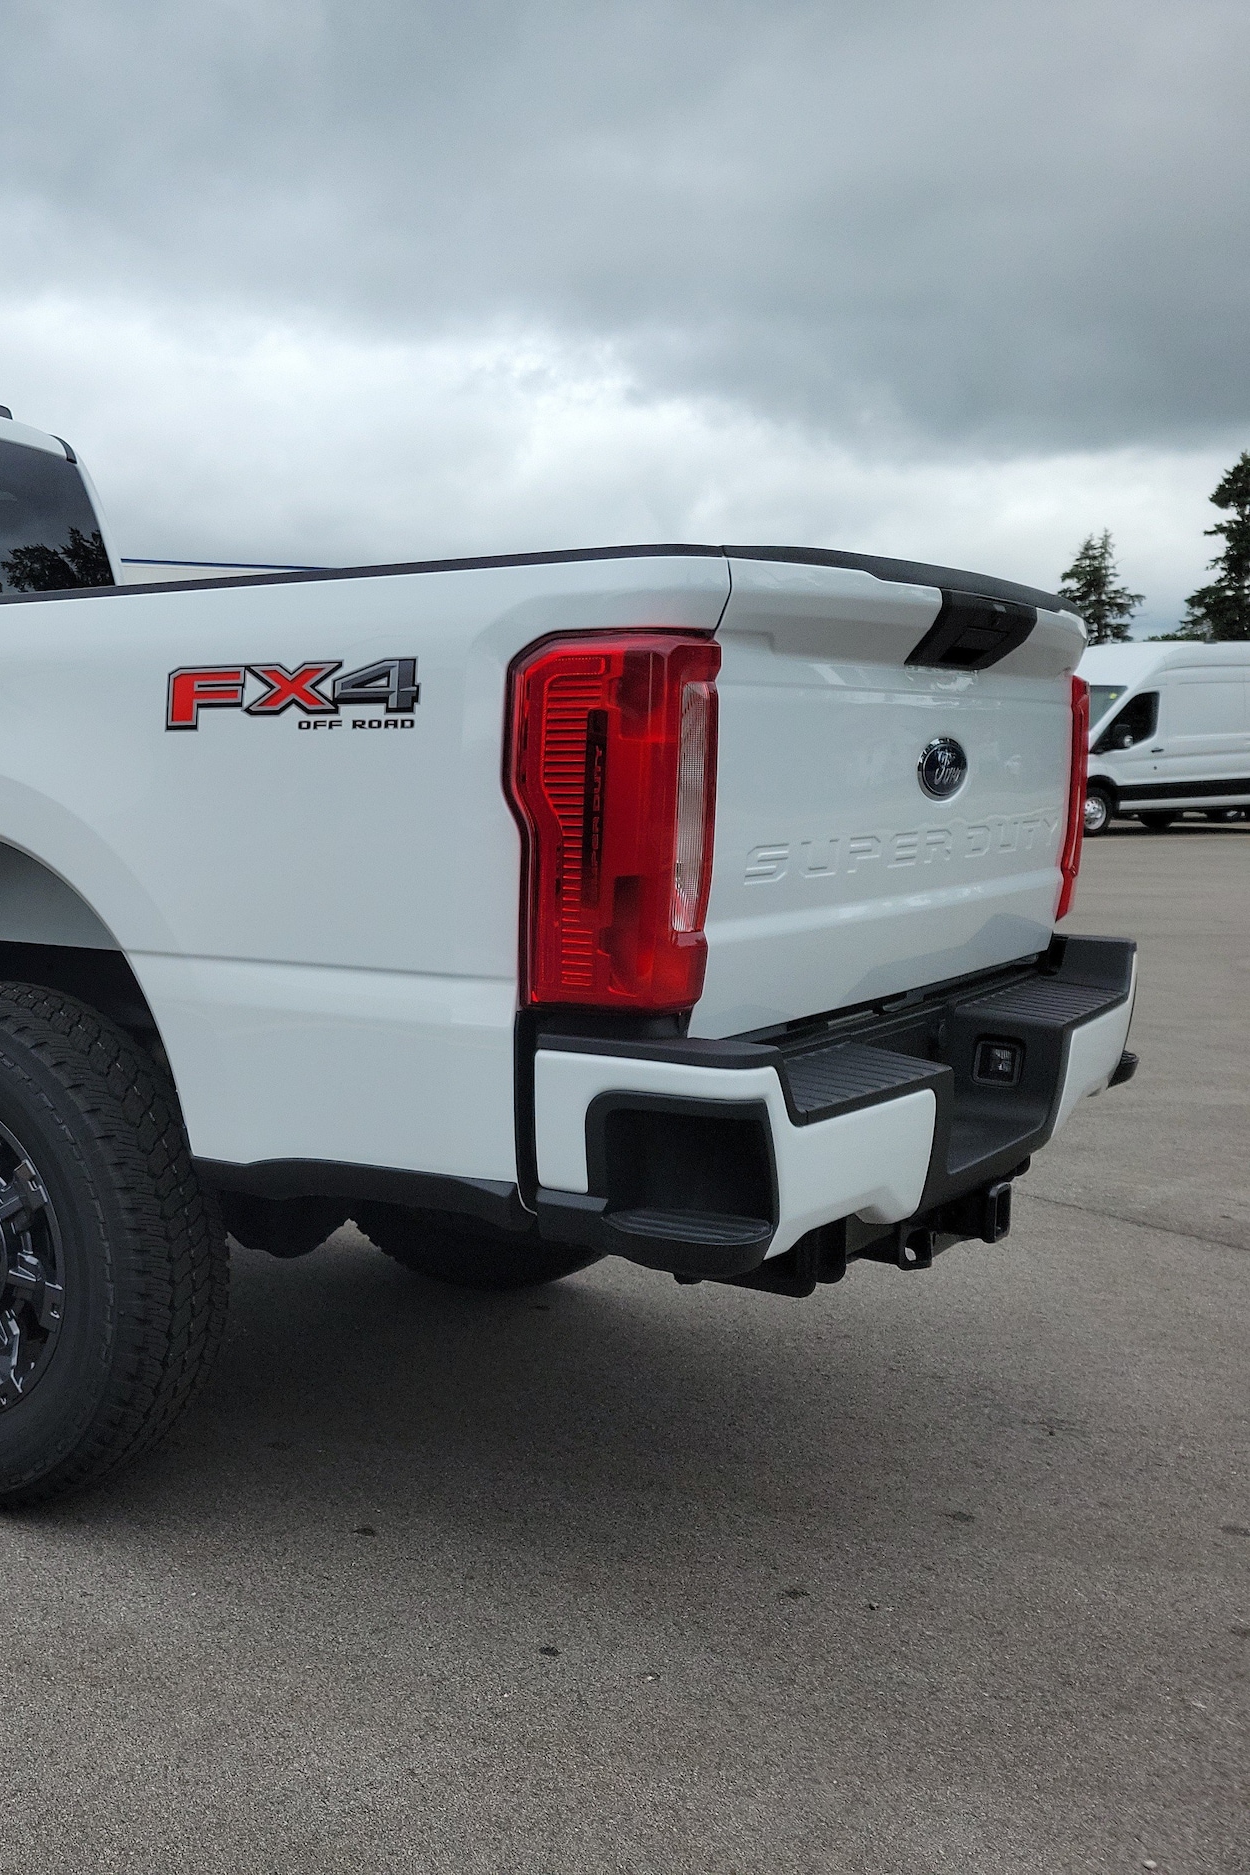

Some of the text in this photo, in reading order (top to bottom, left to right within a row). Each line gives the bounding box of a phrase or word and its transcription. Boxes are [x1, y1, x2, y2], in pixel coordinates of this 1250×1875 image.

[165, 656, 421, 732] FX4
[298, 718, 415, 730] OFF ROAD
[744, 818, 1059, 886] SUPER DUTY
